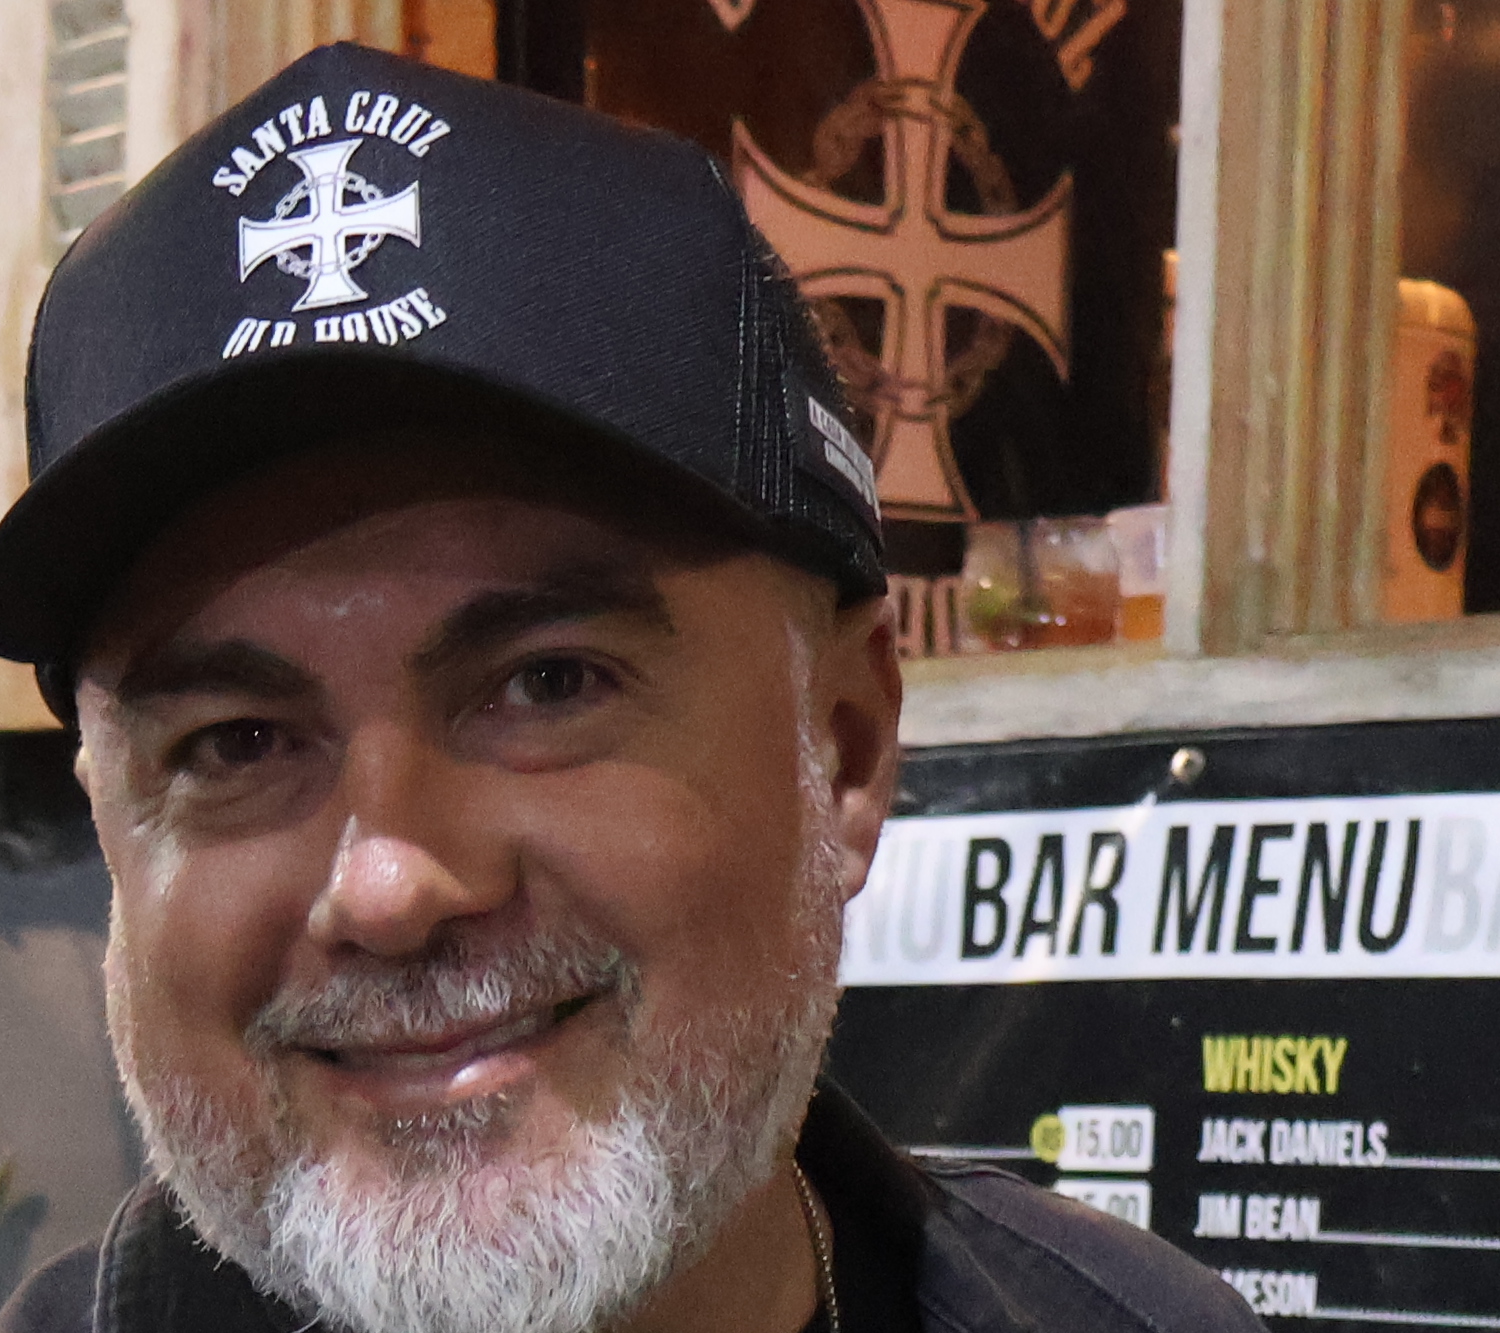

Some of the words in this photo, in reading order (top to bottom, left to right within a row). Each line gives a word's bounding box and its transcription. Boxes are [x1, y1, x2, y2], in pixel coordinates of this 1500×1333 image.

[212, 96, 332, 197] SANTA
[345, 90, 451, 158] CRUZ
[959, 831, 1126, 962] BAR
[1152, 818, 1422, 957] MENU
[1203, 1036, 1348, 1094] WHISKY
[1196, 1118, 1266, 1164] JACK
[1269, 1119, 1389, 1167] DANIELS
[1194, 1193, 1241, 1238] JIM
[1245, 1194, 1320, 1239] BEAN
